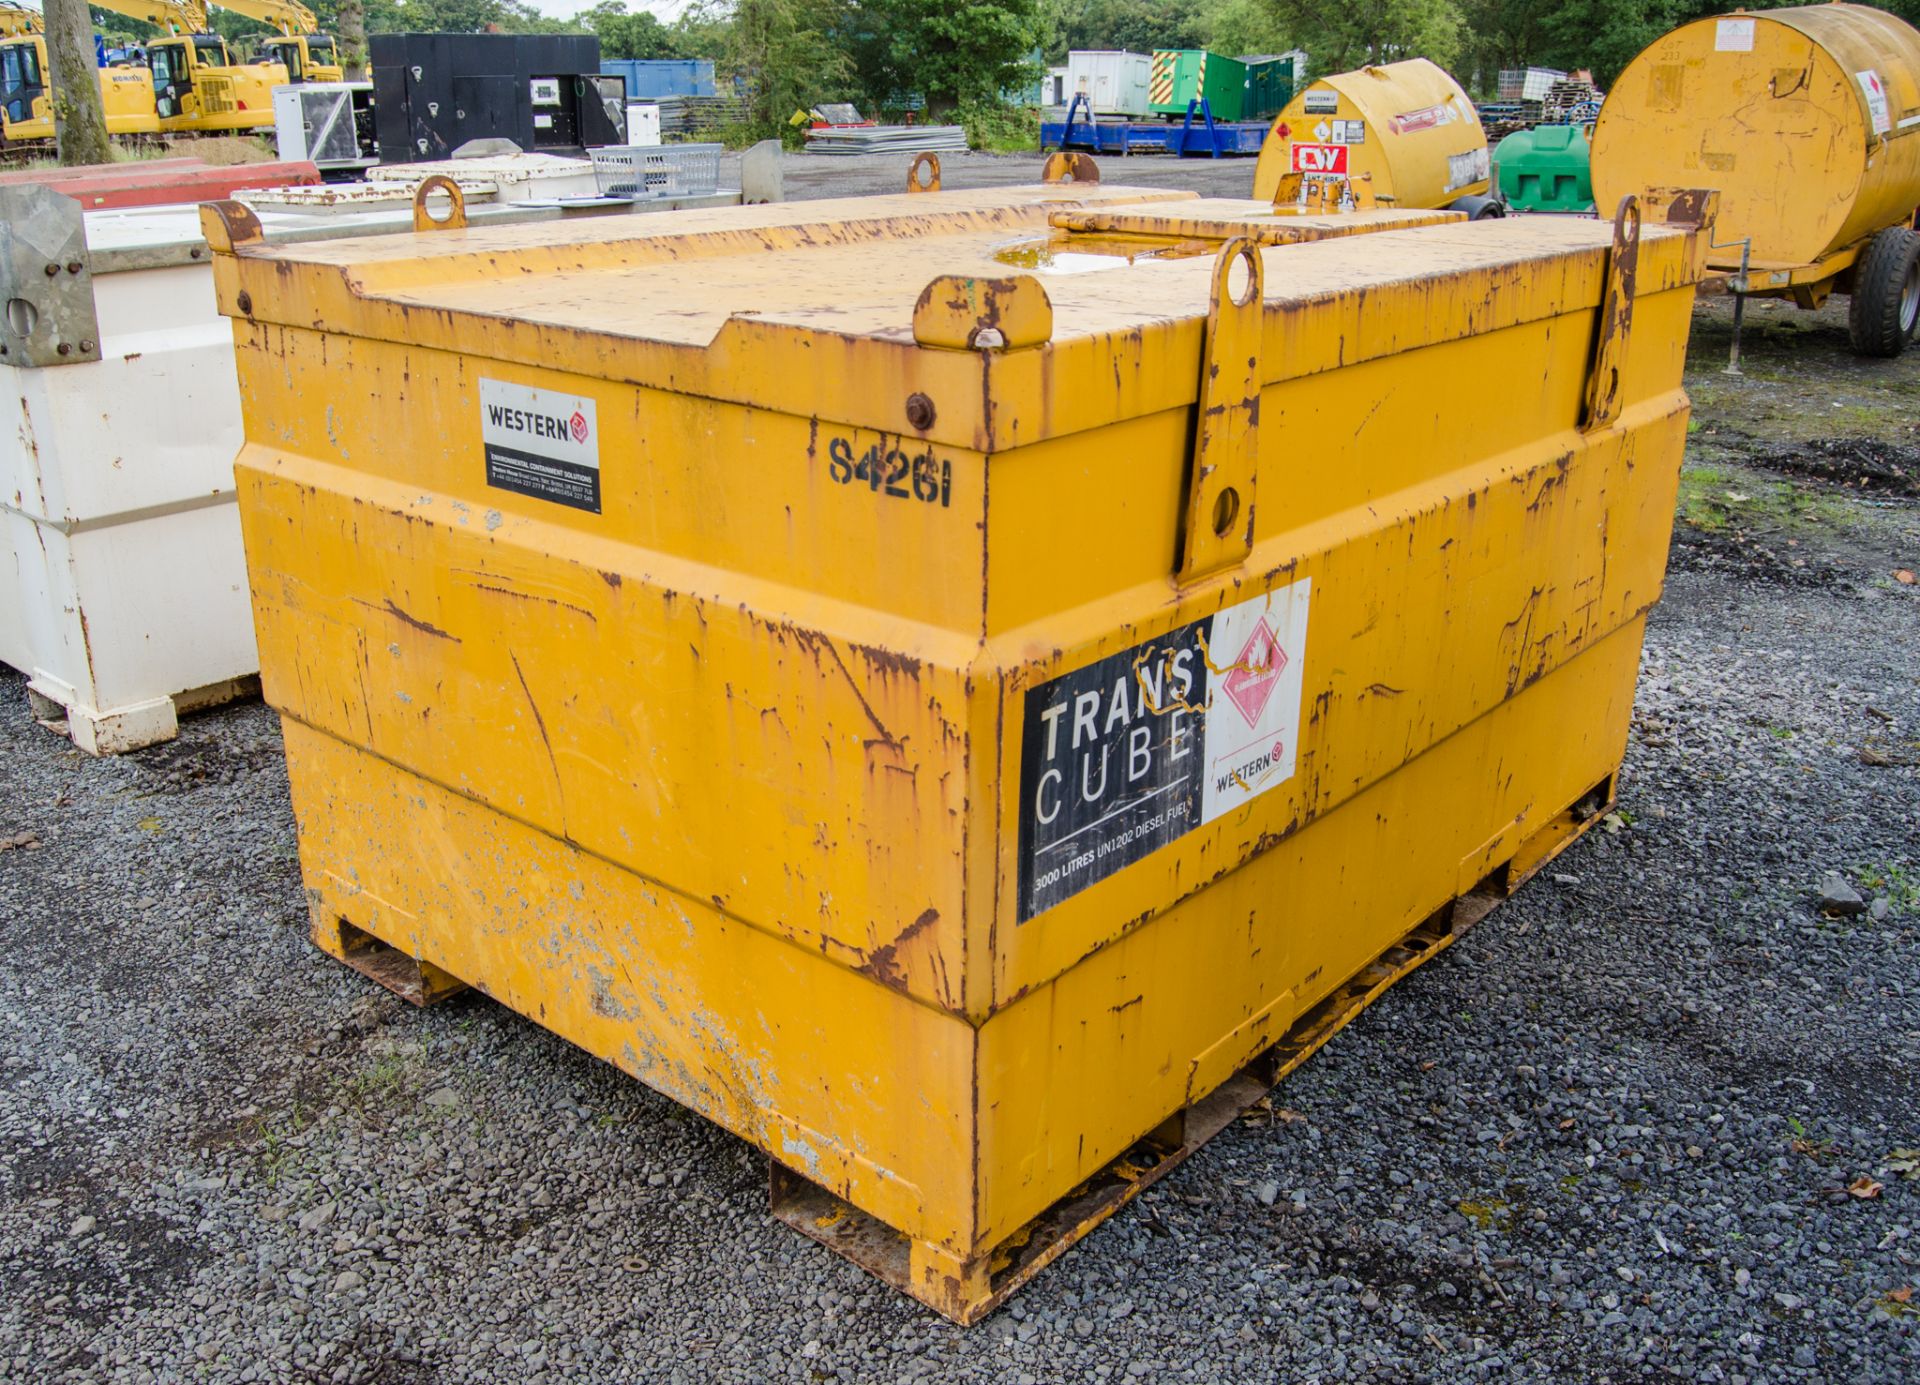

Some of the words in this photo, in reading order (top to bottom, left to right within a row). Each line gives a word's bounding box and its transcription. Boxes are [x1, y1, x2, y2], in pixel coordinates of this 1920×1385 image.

[1298, 146, 1339, 171] CW
[488, 404, 569, 442] WESTERN
[564, 470, 592, 484] SOLUTIONS
[1041, 648, 1194, 761] TRANS
[1036, 708, 1190, 825] CUBE
[1217, 752, 1271, 793] WESTERN
[1034, 868, 1060, 892] 3000
[1062, 849, 1095, 878] LITRES
[1097, 830, 1134, 858] UN1202
[1135, 817, 1166, 839] DIESEL
[1167, 801, 1188, 822] FUEL
